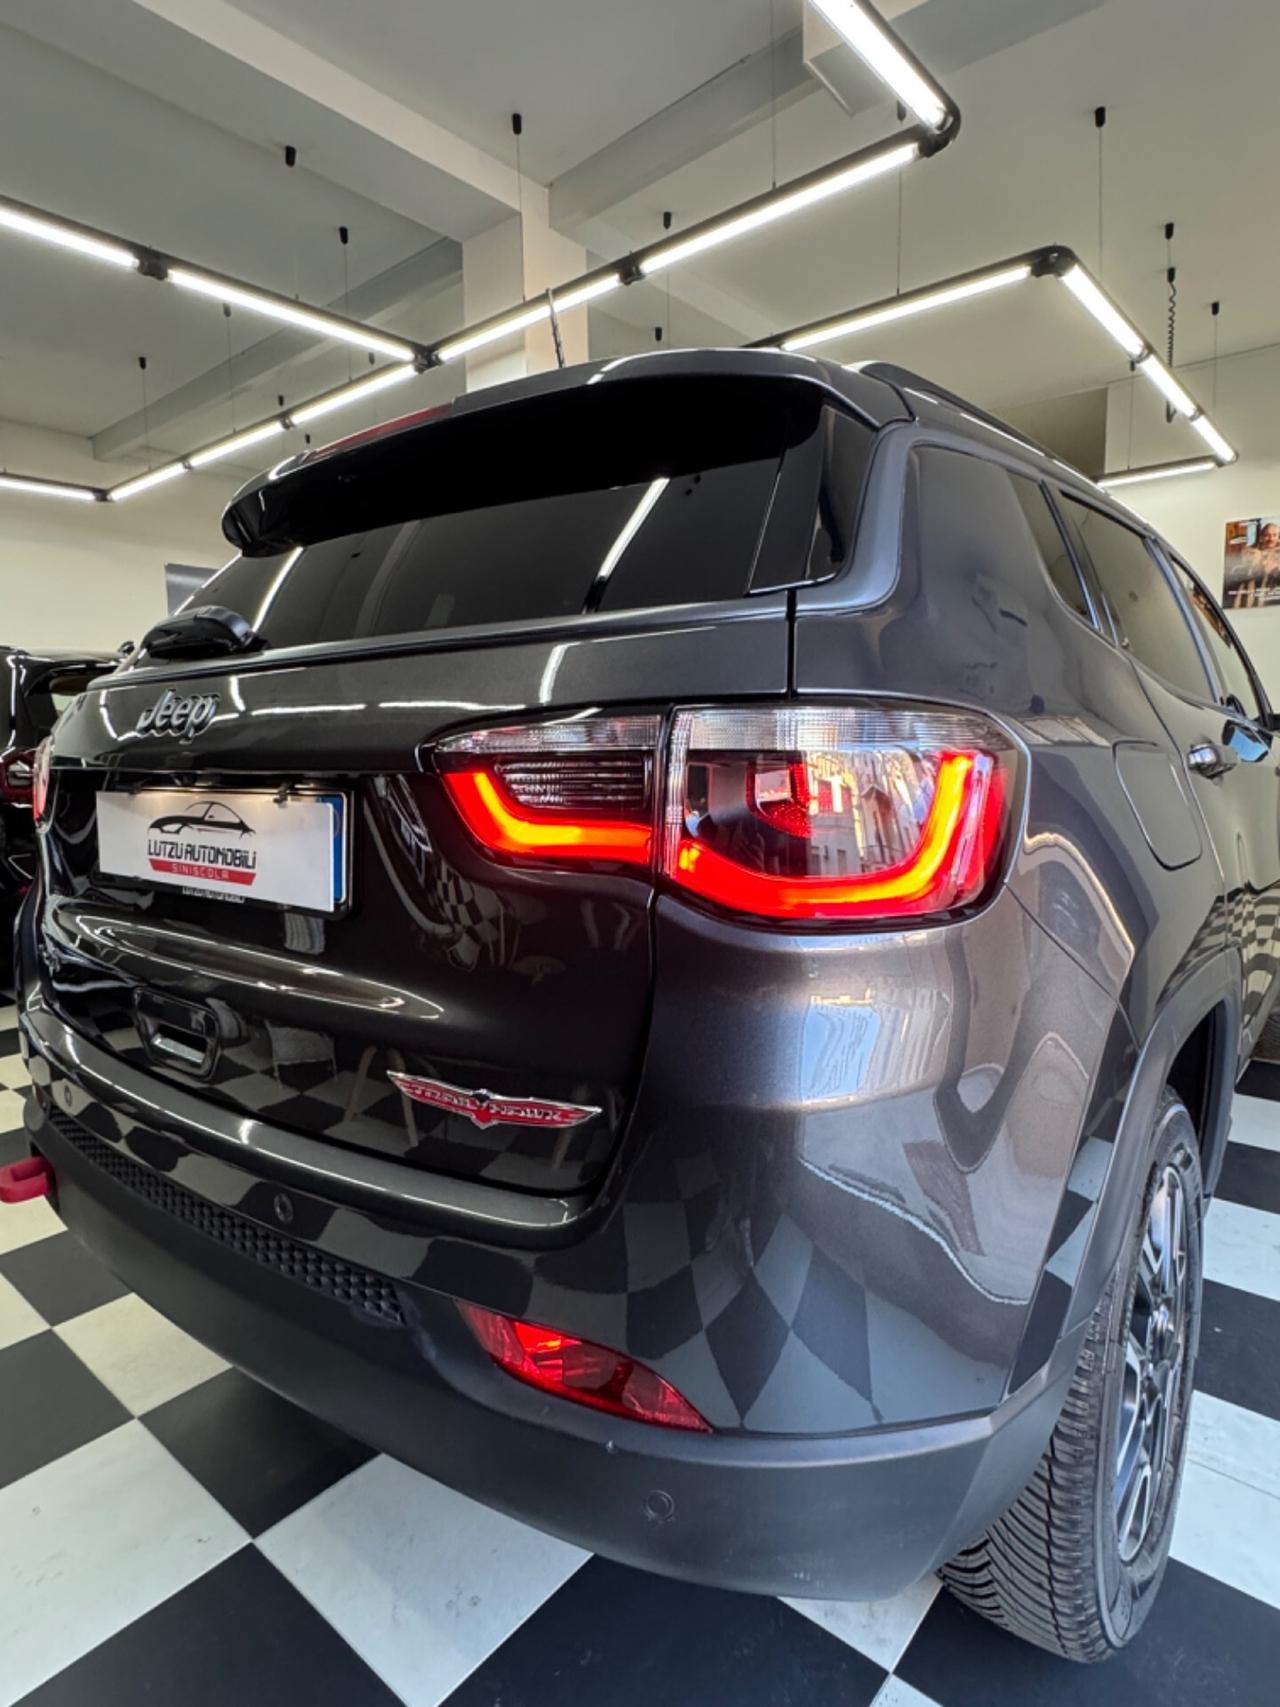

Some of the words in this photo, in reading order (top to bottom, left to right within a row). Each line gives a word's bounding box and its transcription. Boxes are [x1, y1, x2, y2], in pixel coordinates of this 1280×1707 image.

[135, 688, 219, 741] Jeep
[148, 840, 183, 859] LUTZU
[185, 843, 257, 869] AUTOMOBILI
[171, 863, 230, 881] SINISCOLA
